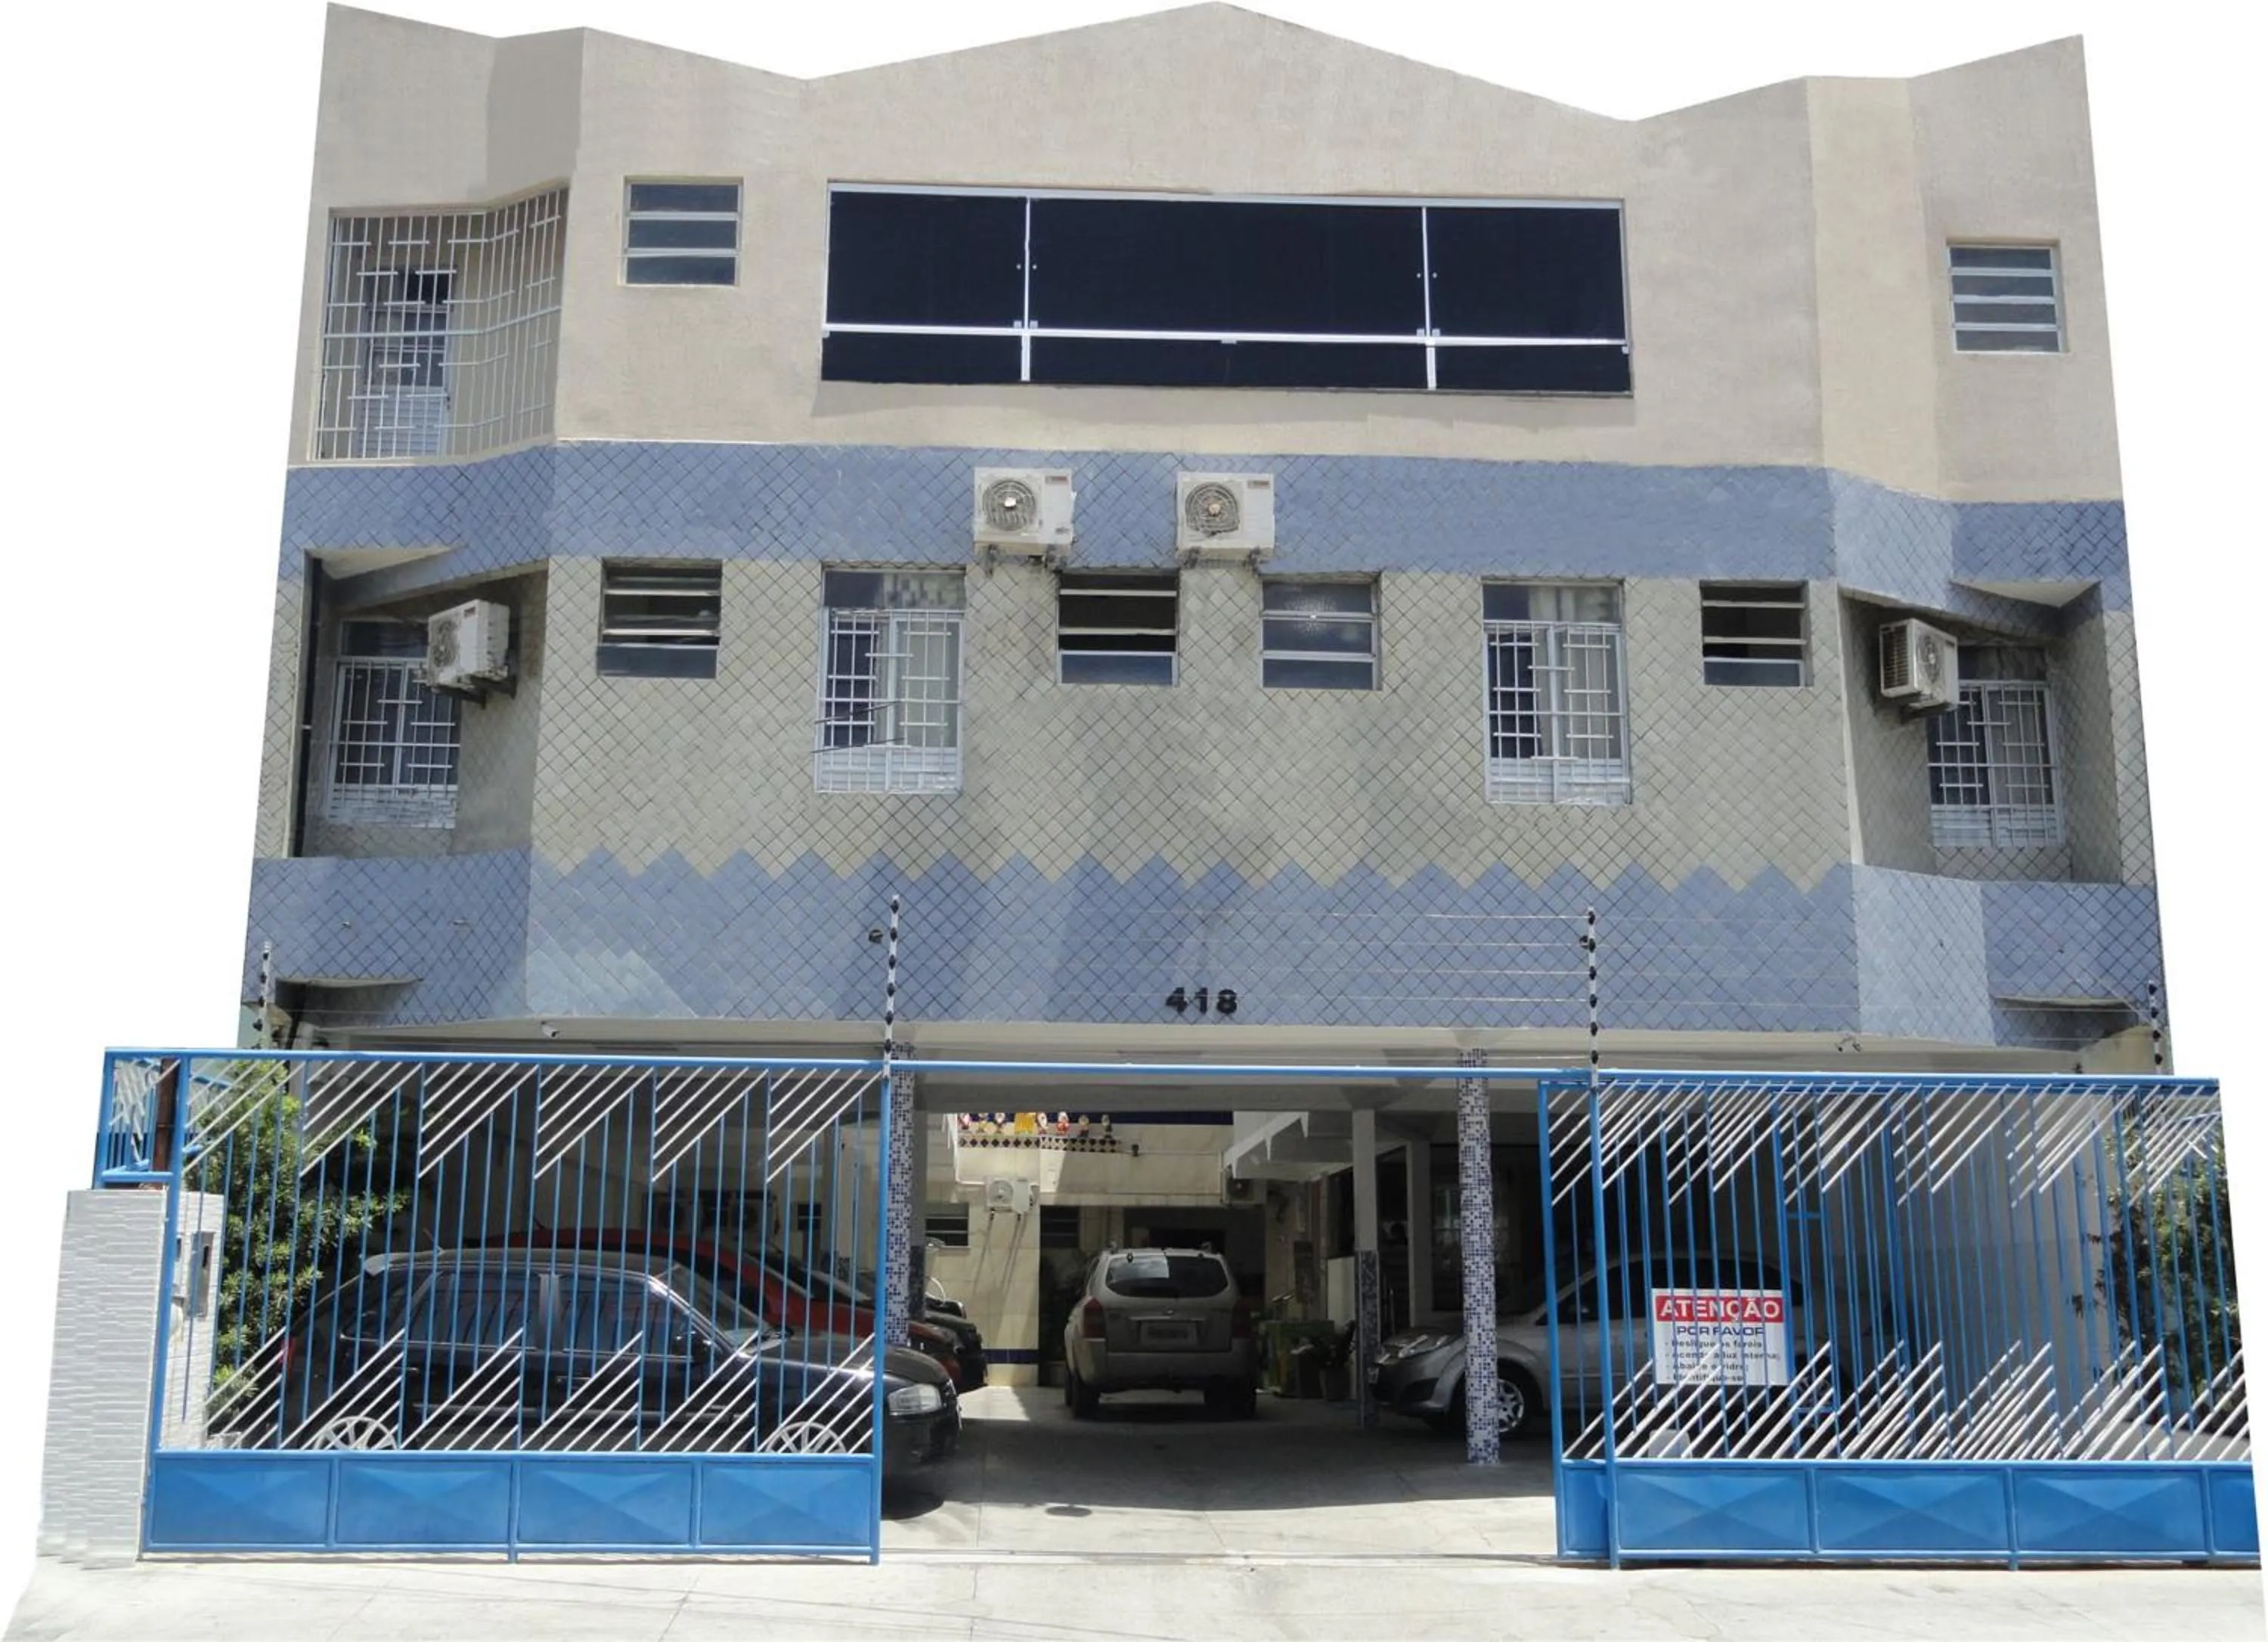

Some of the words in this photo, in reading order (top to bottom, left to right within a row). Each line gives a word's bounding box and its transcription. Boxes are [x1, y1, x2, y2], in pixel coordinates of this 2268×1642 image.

[1165, 987, 1238, 1015] 418
[1660, 1298, 1780, 1321] ATENÇÃO
[1677, 1326, 1709, 1336] POR
[1713, 1326, 1765, 1337] FAVOR
